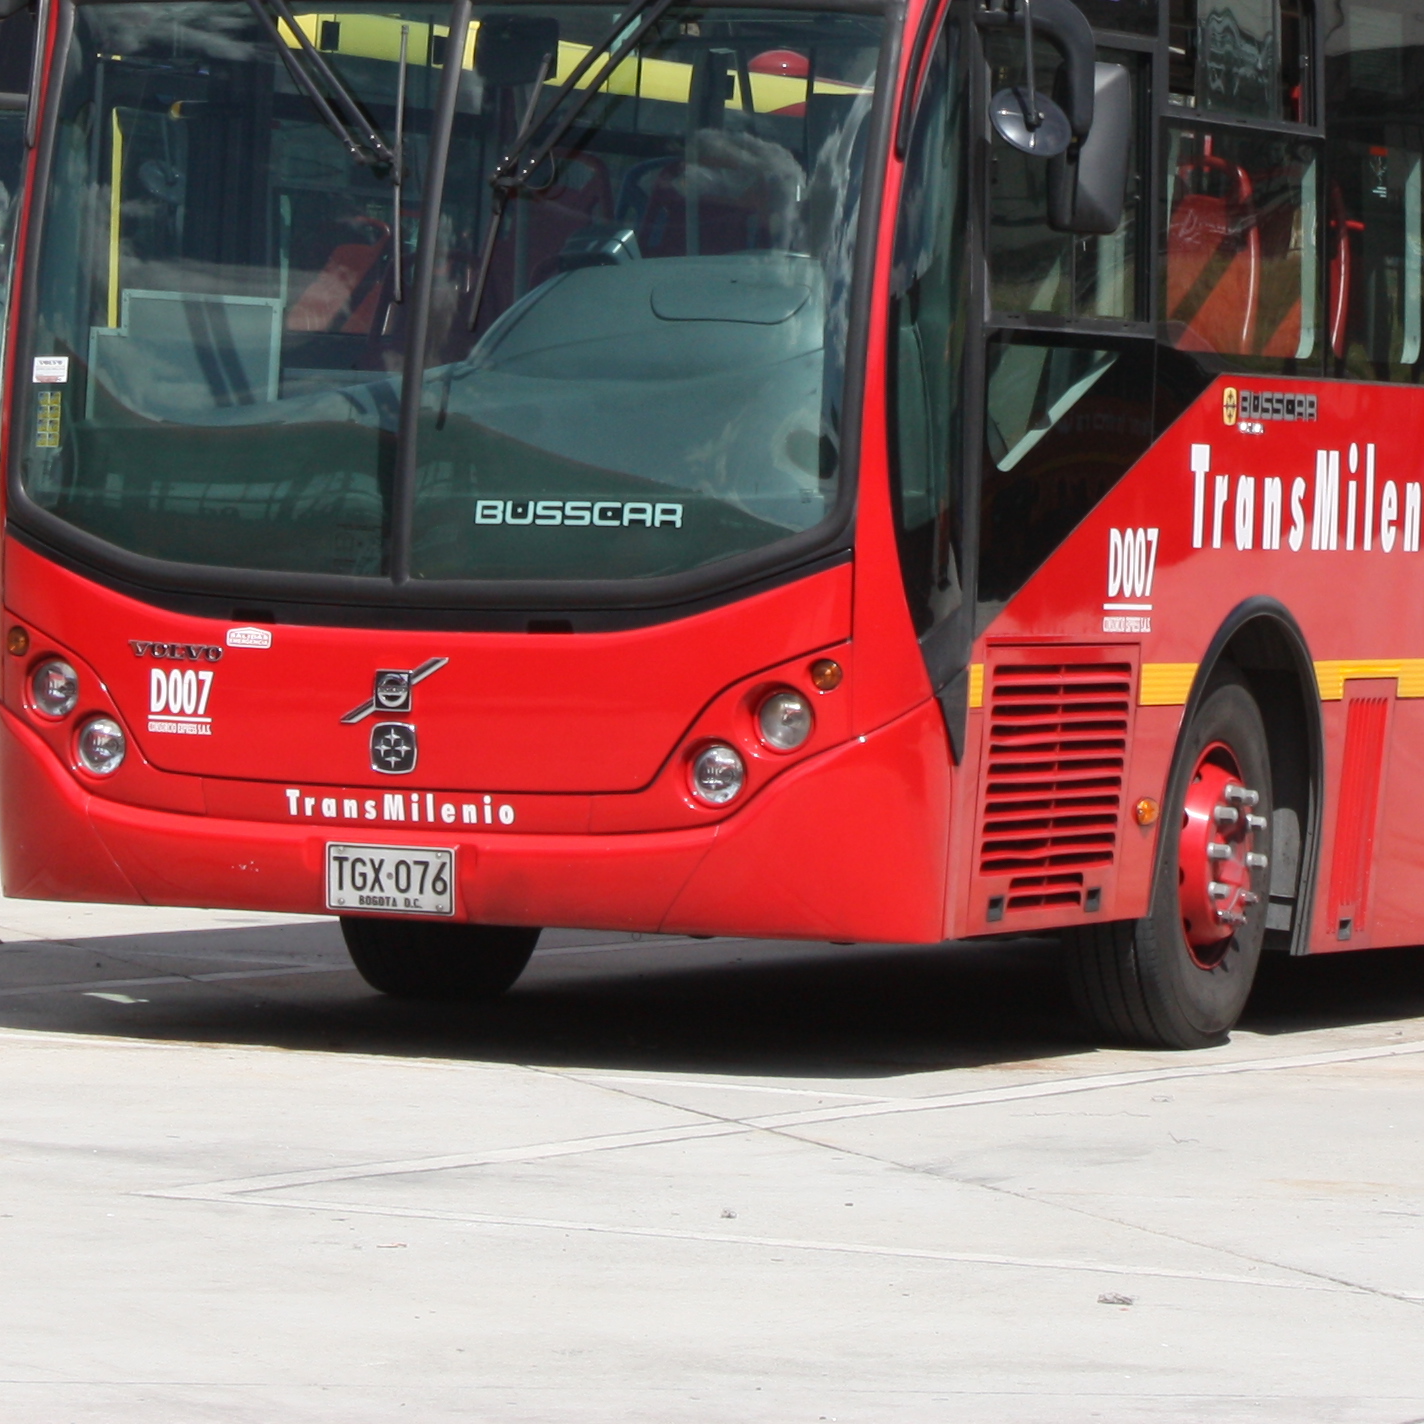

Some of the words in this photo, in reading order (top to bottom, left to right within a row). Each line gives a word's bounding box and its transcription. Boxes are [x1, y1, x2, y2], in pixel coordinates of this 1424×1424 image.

[1239, 390, 1318, 422] BUSSCAR
[475, 500, 683, 528] BUSSCAR
[1107, 527, 1159, 598] D007
[128, 640, 224, 662] VOLVO
[150, 668, 214, 715] D007
[285, 788, 515, 825] TransMilenio
[359, 895, 397, 907] BOGOTA
